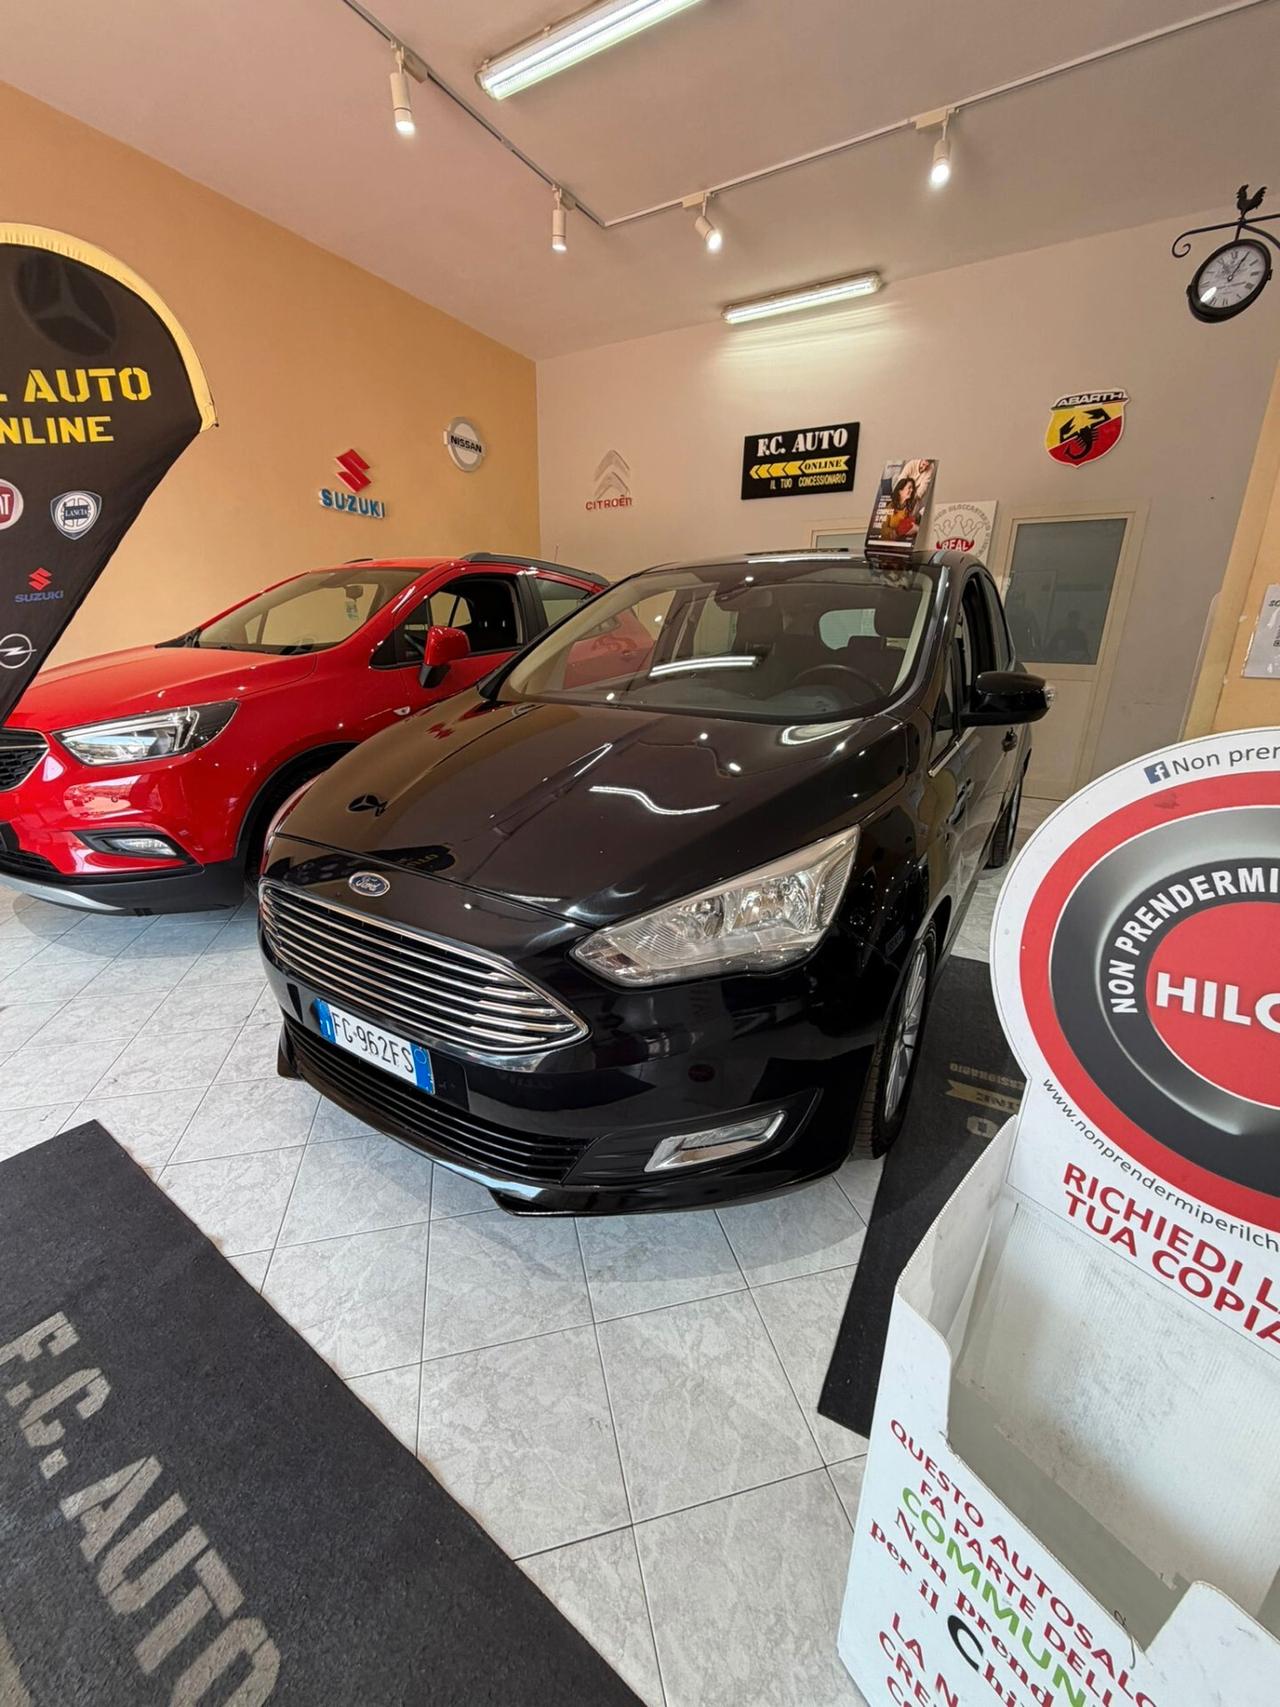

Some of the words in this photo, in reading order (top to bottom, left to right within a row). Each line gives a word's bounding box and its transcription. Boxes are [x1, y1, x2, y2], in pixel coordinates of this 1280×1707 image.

[23, 367, 152, 403] AUTO
[1057, 391, 1124, 407] ABARTH
[0, 415, 114, 444] NLINE
[450, 434, 482, 454] NISSAN
[792, 427, 848, 453] AUTO
[780, 478, 792, 489] TUO
[798, 474, 846, 488] CONCESSIONARIO
[804, 458, 843, 472] ONLINE
[319, 487, 385, 519] SUZUKI
[942, 538, 969, 552] REAL
[15, 590, 64, 603] SUZUKI
[1172, 753, 1220, 775] Non
[1114, 867, 1279, 957] PRENDERMI
[1108, 959, 1139, 1013] NON
[1063, 1163, 1243, 1286] RICHIEDI
[1256, 1276, 1280, 1314] L
[1065, 1190, 1138, 1258] TUA
[1151, 1249, 1280, 1345] COPIA
[890, 1419, 984, 1528] QUESTO
[894, 1506, 947, 1586] Non
[920, 1479, 946, 1520] FA
[954, 1518, 1037, 1621] PARTE
[59, 1454, 281, 1707] AUTO
[902, 1487, 1087, 1707] COMMUN
[869, 1518, 913, 1576] per
[918, 1579, 939, 1614] il
[947, 1614, 1024, 1707] Chi
[878, 1631, 936, 1707] CRE
[892, 1612, 926, 1672] LA
